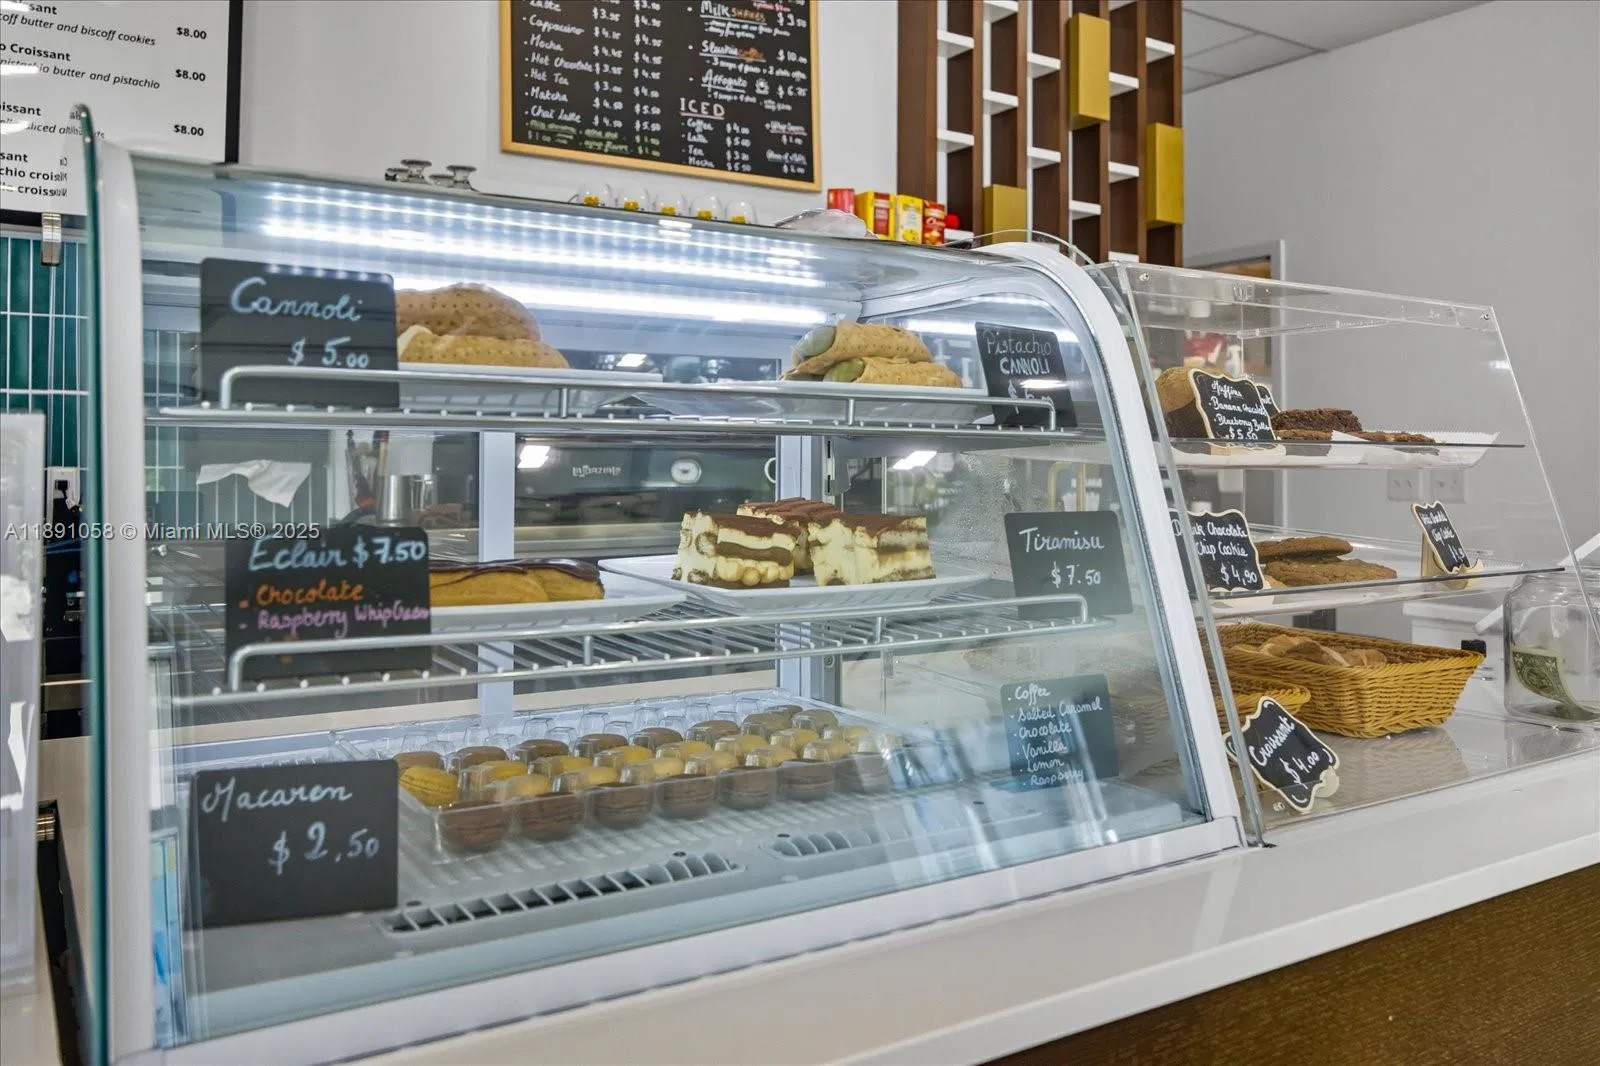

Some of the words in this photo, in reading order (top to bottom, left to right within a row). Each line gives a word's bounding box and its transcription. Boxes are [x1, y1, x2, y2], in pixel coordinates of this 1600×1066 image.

[20, 15, 54, 29] butter
[56, 23, 79, 33] and
[80, 25, 117, 41] biscoff
[117, 31, 156, 46] cookies
[176, 26, 207, 40] $8.00
[10, 42, 71, 62] Croissant
[530, 34, 564, 51] Mocha
[530, 52, 549, 66] Hot
[52, 65, 86, 79] butter
[89, 72, 111, 82] and
[112, 73, 160, 90] pistachio
[175, 68, 206, 82] $8.00
[530, 68, 547, 81] Hot
[554, 72, 569, 85] Tea
[530, 86, 568, 102] Matcha
[680, 97, 725, 117] ICED
[173, 124, 204, 137] $8.00
[230, 276, 363, 322] Cannoli
[999, 356, 1051, 376] CANNOLI
[1210, 396, 1243, 412] Banana
[1018, 526, 1105, 553] Tiramisu
[1206, 521, 1248, 538] Chocolate
[248, 535, 347, 571] Eclair
[1196, 540, 1217, 561] Chip
[1218, 541, 1248, 557] Cookie
[256, 579, 364, 606] Chocolate
[258, 605, 348, 639] Raspberry
[1014, 682, 1051, 706] Coffee
[1018, 704, 1056, 722] Salted
[1018, 721, 1072, 739] Chocolate
[1022, 739, 1067, 760] Vanilla
